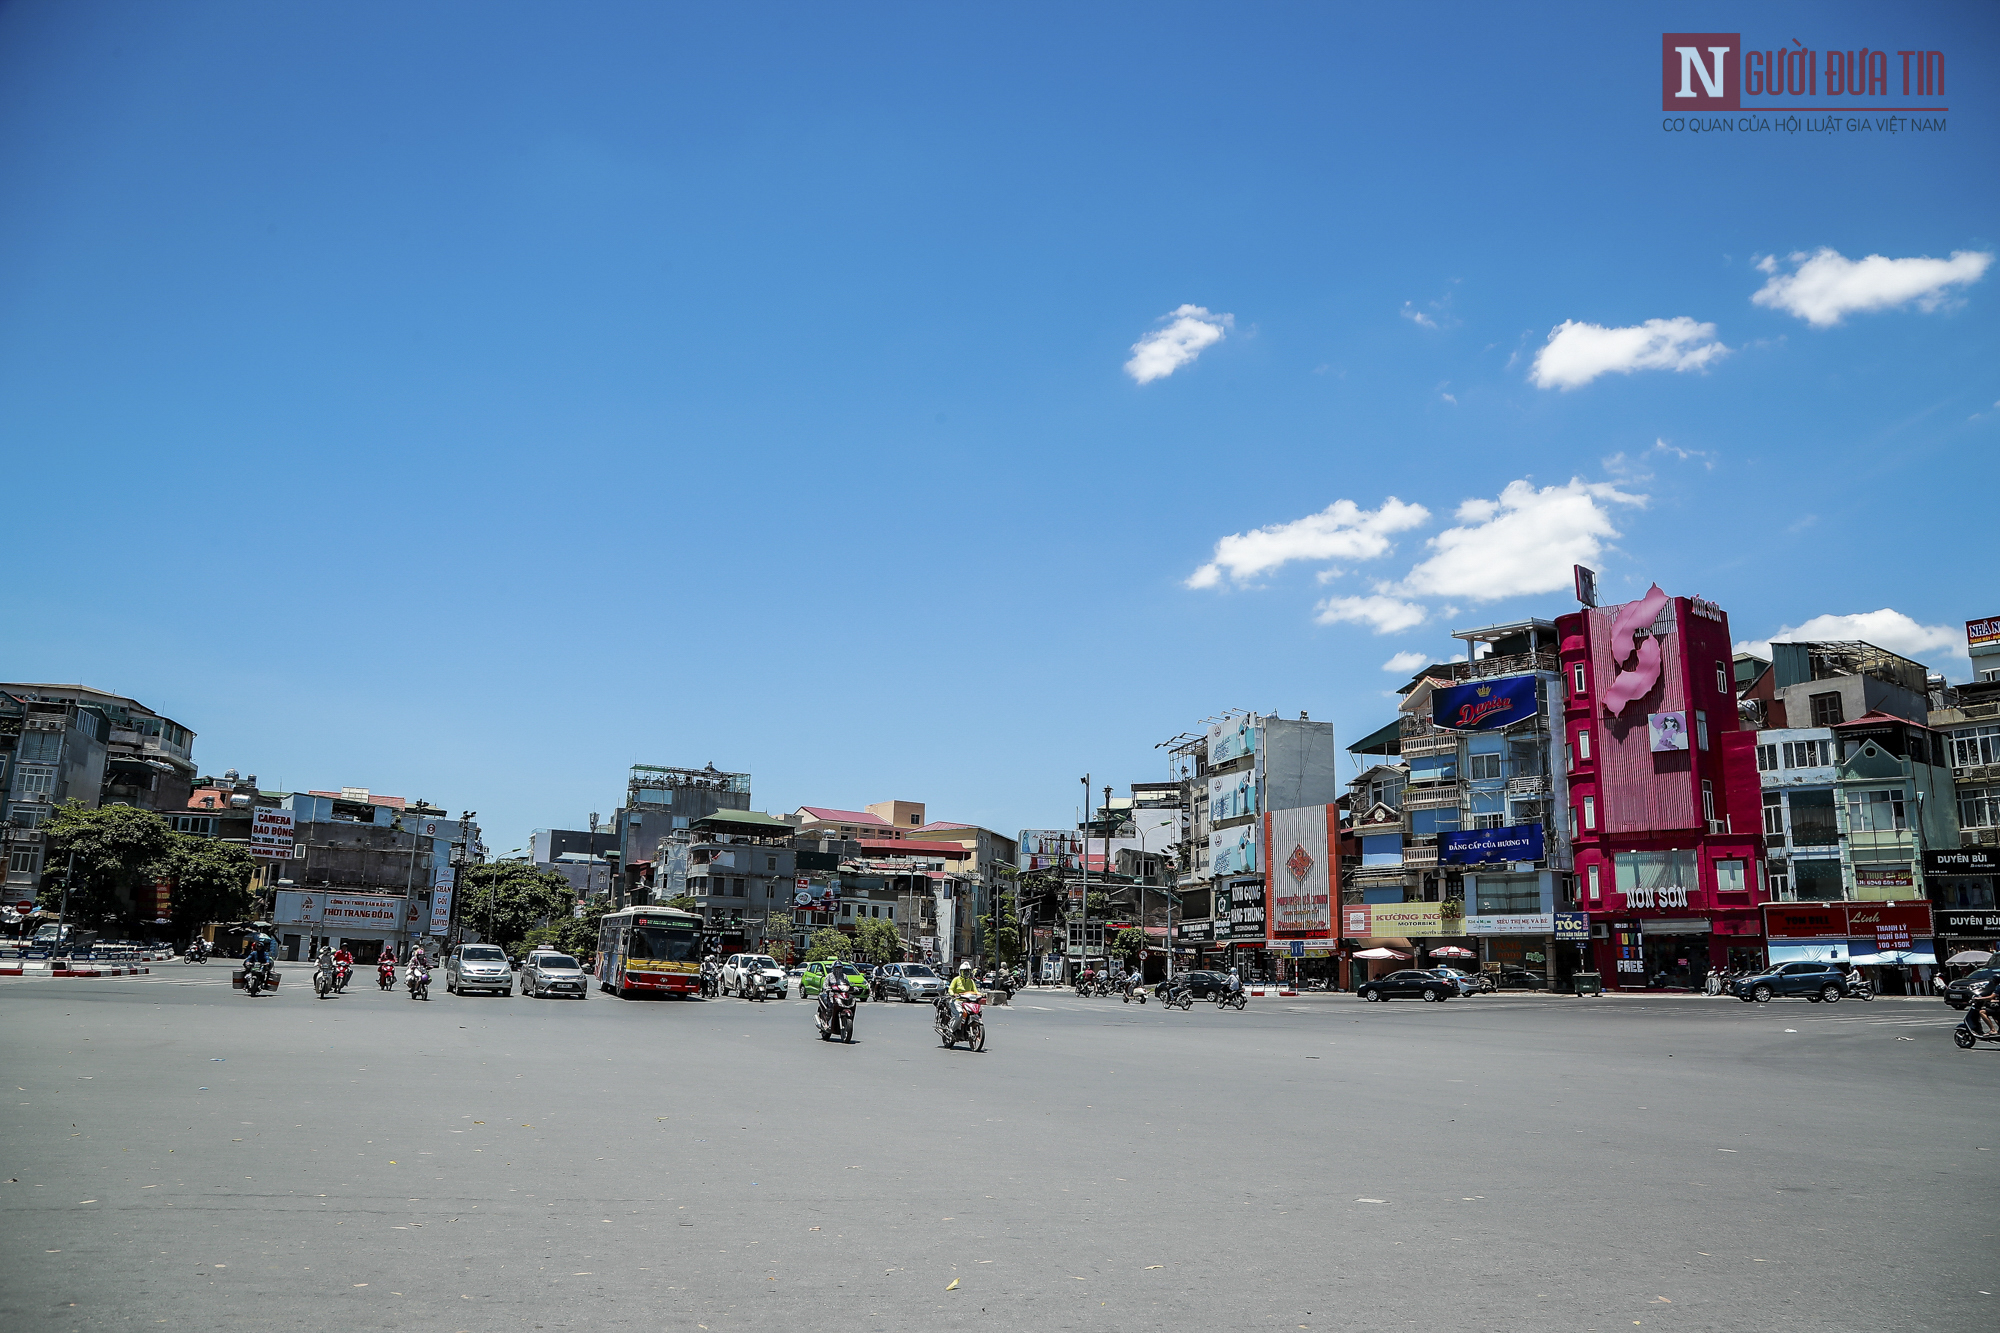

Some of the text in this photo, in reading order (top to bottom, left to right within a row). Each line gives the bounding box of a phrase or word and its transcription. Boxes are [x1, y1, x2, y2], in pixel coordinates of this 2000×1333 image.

[1456, 695, 1514, 727] Danisa
[258, 814, 290, 825] CAMERA
[253, 824, 269, 834] BÁO
[1468, 841, 1481, 849] CẤP
[1937, 852, 1987, 863] DUYÊN BÙI
[1244, 885, 1261, 904] GỌNG
[1626, 884, 1688, 908] NÓN SƠN
[324, 907, 342, 916] THỜI
[1244, 903, 1264, 922] THÙNG
[1850, 912, 1880, 923] Linh
[1556, 918, 1582, 930] TÓC
[1950, 916, 1982, 925] DUYÊN
[1493, 938, 1521, 950] VÀNG
[1616, 933, 1642, 945] BUY 1
[1616, 947, 1643, 959] GET 1
[1617, 960, 1644, 972] FREE
